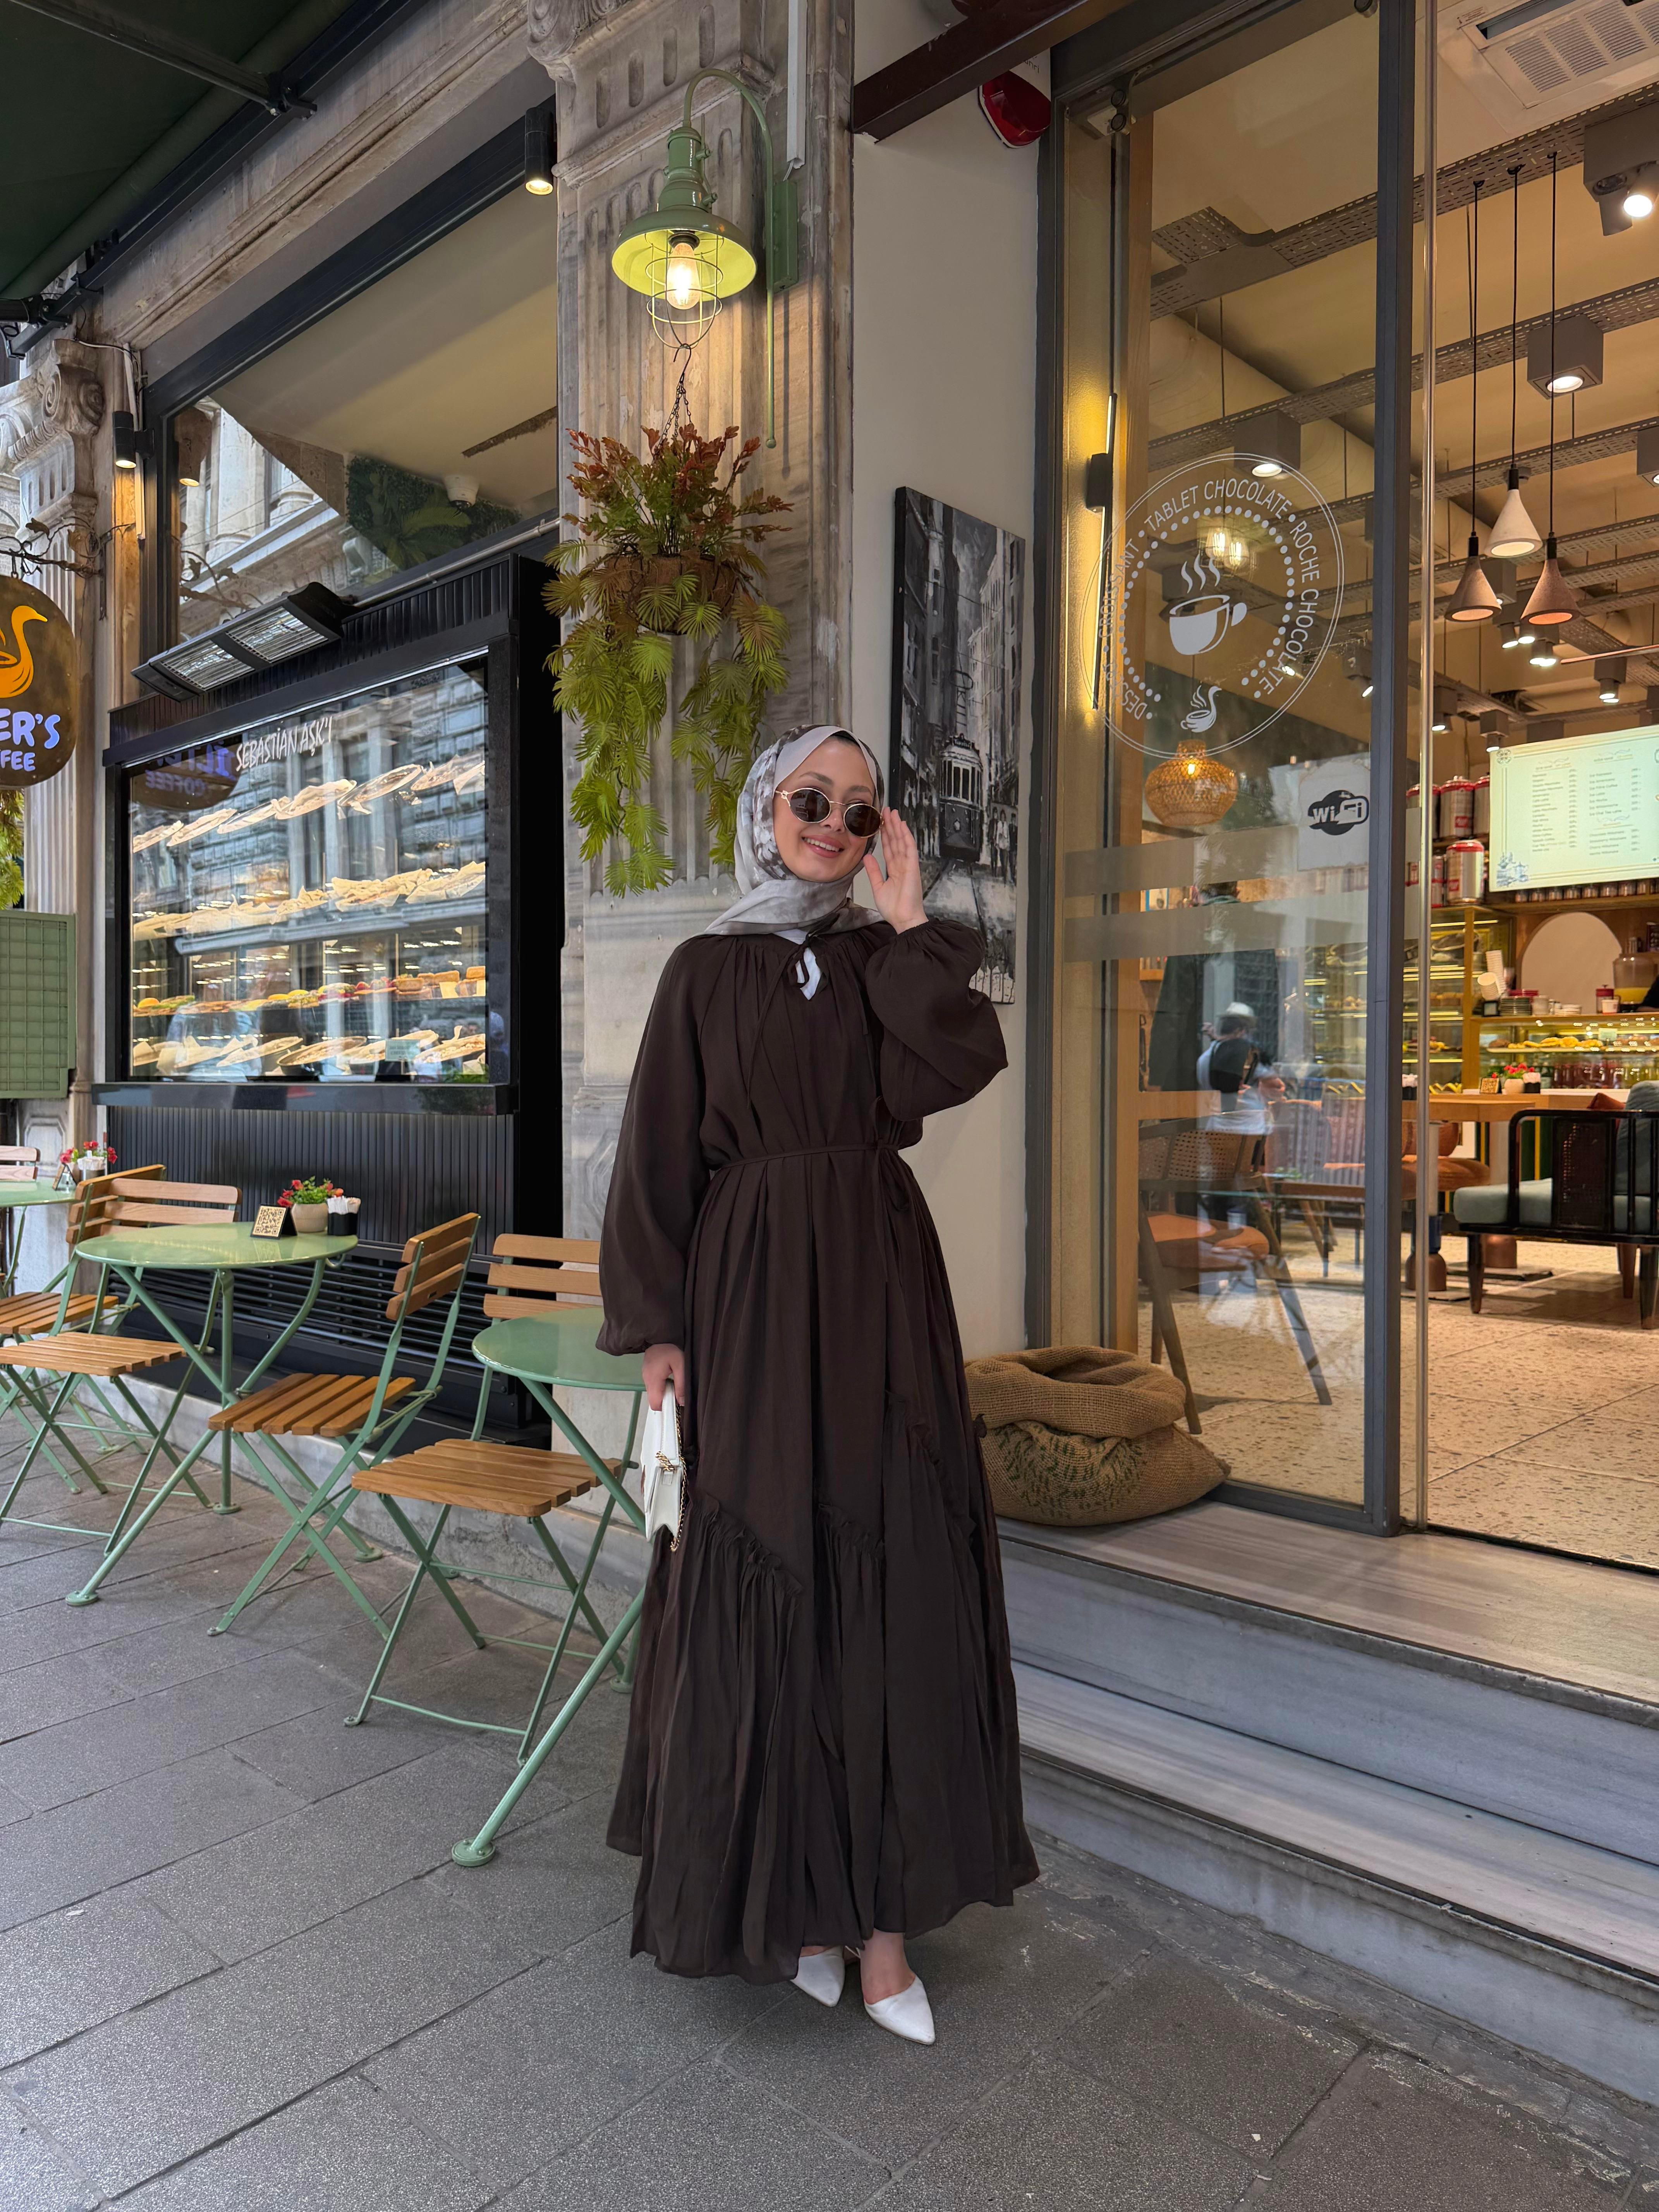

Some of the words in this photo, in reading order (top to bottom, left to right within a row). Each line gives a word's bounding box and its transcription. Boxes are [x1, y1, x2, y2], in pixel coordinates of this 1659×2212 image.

[1144, 485, 1199, 531] TABLET
[1204, 478, 1292, 519] CHOCOLATE
[1099, 538, 1139, 638] CROISSANT
[1290, 520, 1319, 583] ROCHE
[1259, 588, 1319, 695] CHOCOLATE
